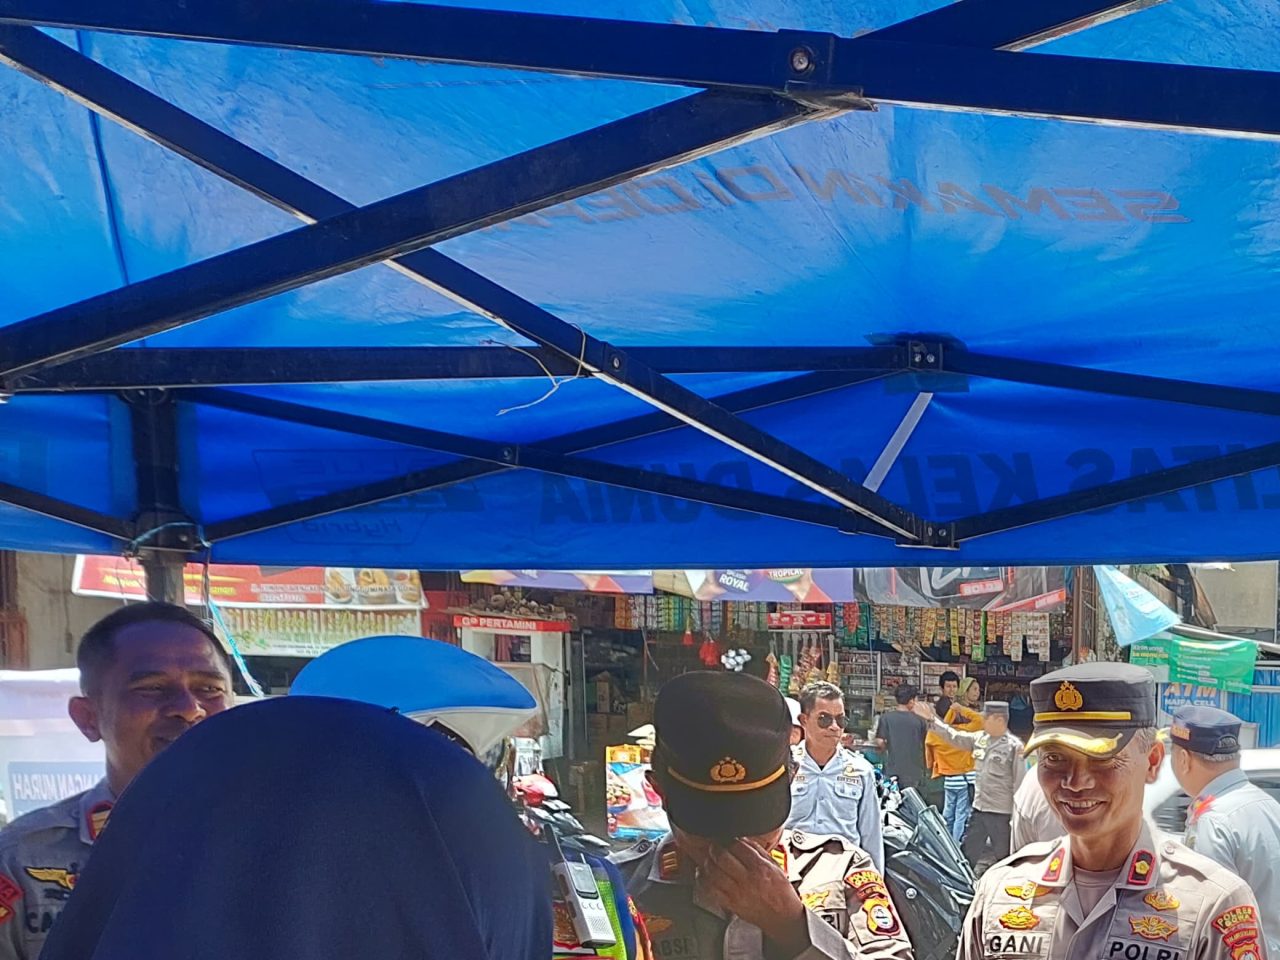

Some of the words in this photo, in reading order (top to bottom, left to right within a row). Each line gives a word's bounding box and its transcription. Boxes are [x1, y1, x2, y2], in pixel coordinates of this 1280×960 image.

[719, 575, 749, 593] ROYAL
[479, 617, 537, 630] PERTAMINI
[988, 935, 1043, 954] GANI
